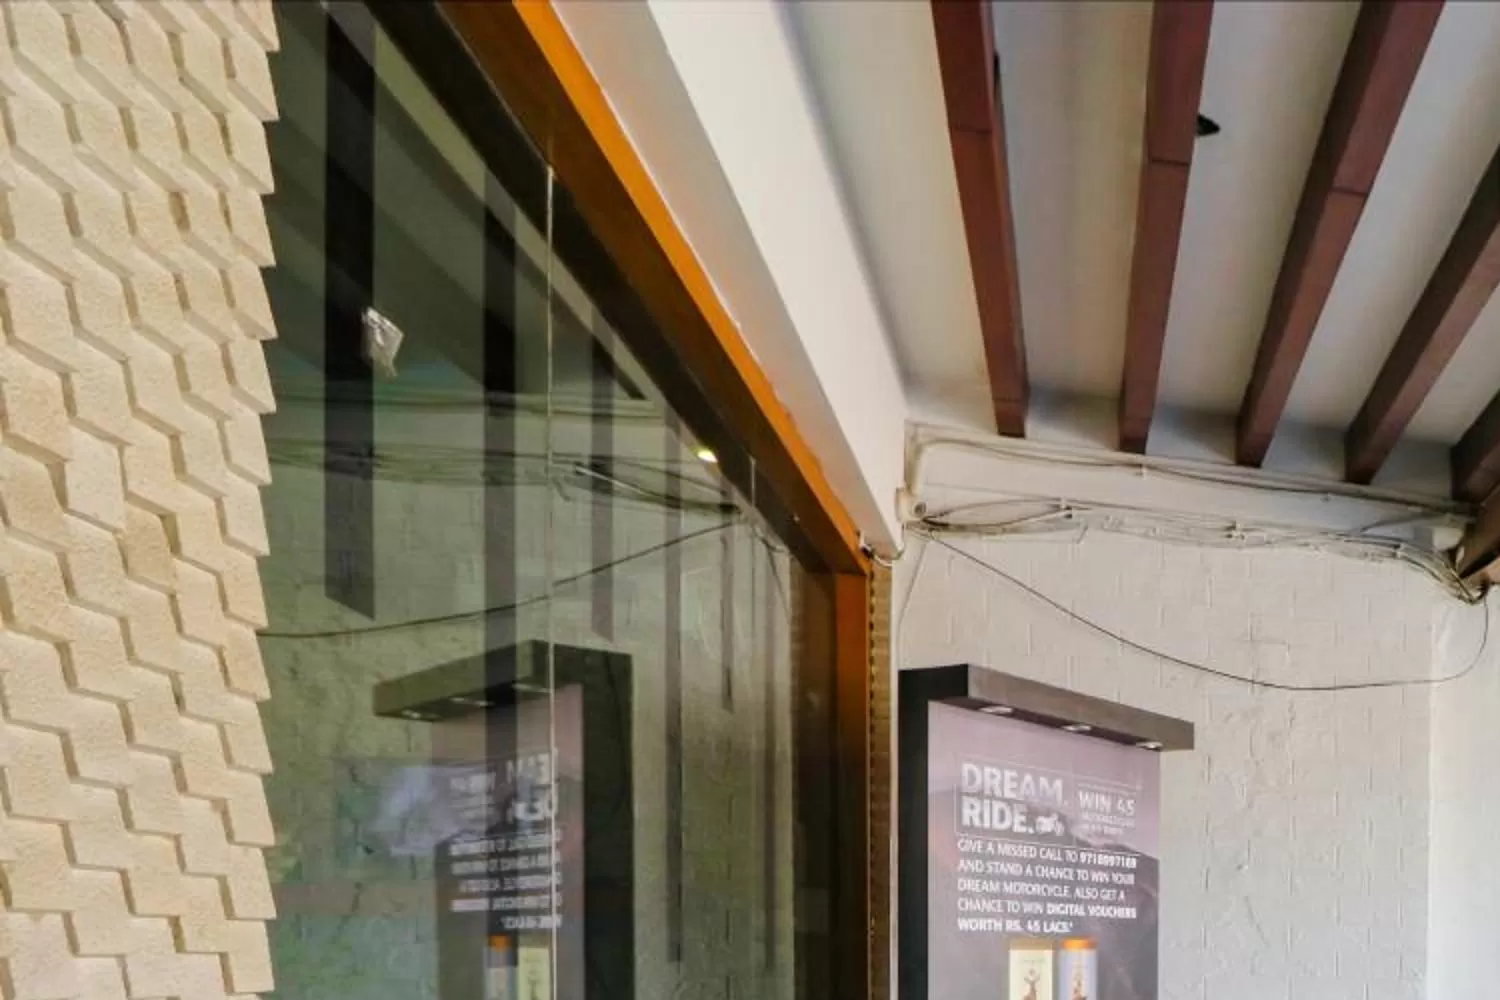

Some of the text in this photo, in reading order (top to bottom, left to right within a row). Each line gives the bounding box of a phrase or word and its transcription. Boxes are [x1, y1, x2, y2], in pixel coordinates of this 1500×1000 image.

[958, 838, 983, 853] GIVE
[987, 841, 996, 855] A
[998, 843, 1037, 858] MISSED
[1040, 847, 1063, 861] CALL
[1065, 849, 1079, 863] TO
[958, 858, 985, 873] AND
[986, 861, 1023, 877] STAND
[1025, 863, 1034, 877] A
[1035, 865, 1075, 881] CHANCE
[1077, 868, 1089, 881] TO
[1091, 870, 1110, 884] WIN
[958, 878, 1000, 894] DREAM
[1074, 887, 1099, 900] ALSO
[1100, 889, 1117, 901] GET
[1118, 889, 1126, 902] A
[958, 897, 1137, 919] CHANCE TO WIN DIGITAL VOUCHERS
[958, 917, 1003, 932] WORTH
